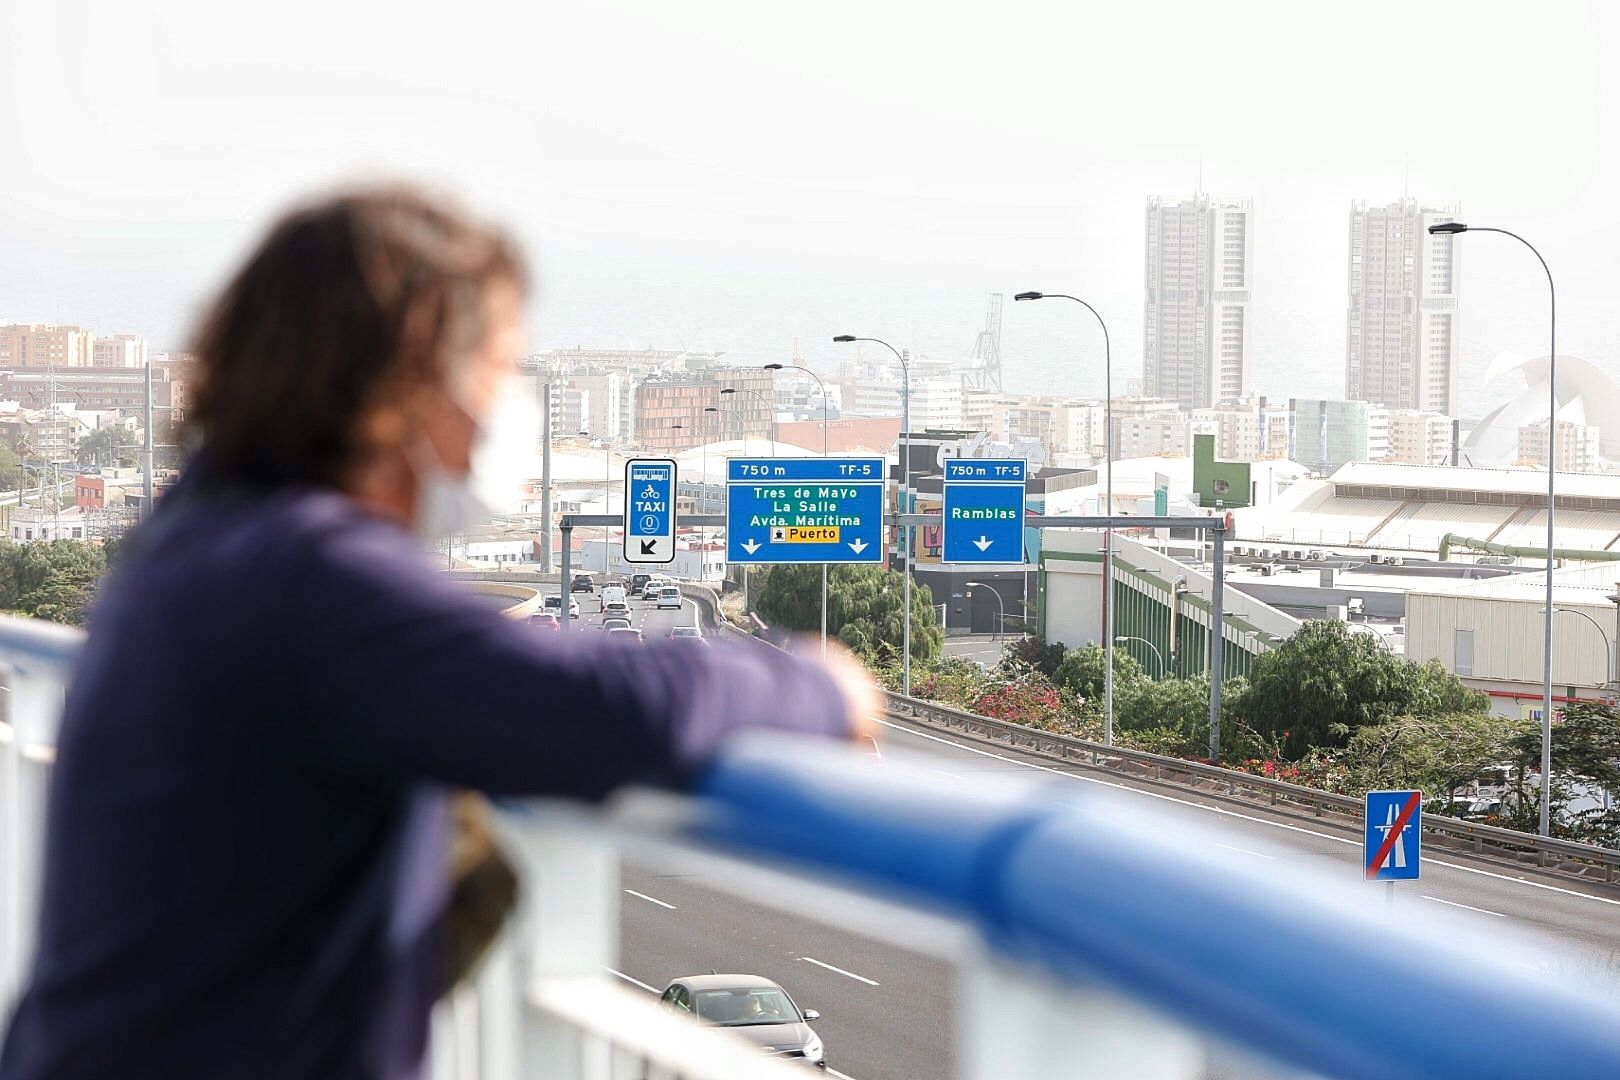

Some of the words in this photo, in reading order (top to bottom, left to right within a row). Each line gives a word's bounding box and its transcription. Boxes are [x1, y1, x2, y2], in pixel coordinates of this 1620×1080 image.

[741, 465, 769, 476] 750
[774, 468, 786, 476] m
[839, 465, 871, 475] TF-5
[950, 466, 974, 476] 750
[976, 468, 986, 476] m
[994, 466, 1020, 476] TF-5
[753, 487, 786, 499] Tres
[794, 487, 811, 498] de
[818, 487, 858, 499] Mayo
[635, 501, 665, 512] TAXI
[773, 501, 791, 513] La
[800, 501, 837, 513] Salle
[952, 508, 1016, 519] Ramblas
[645, 516, 654, 527] 0
[750, 516, 788, 526] Avda.
[795, 514, 861, 526] Marítima
[789, 528, 836, 539] Puerto
